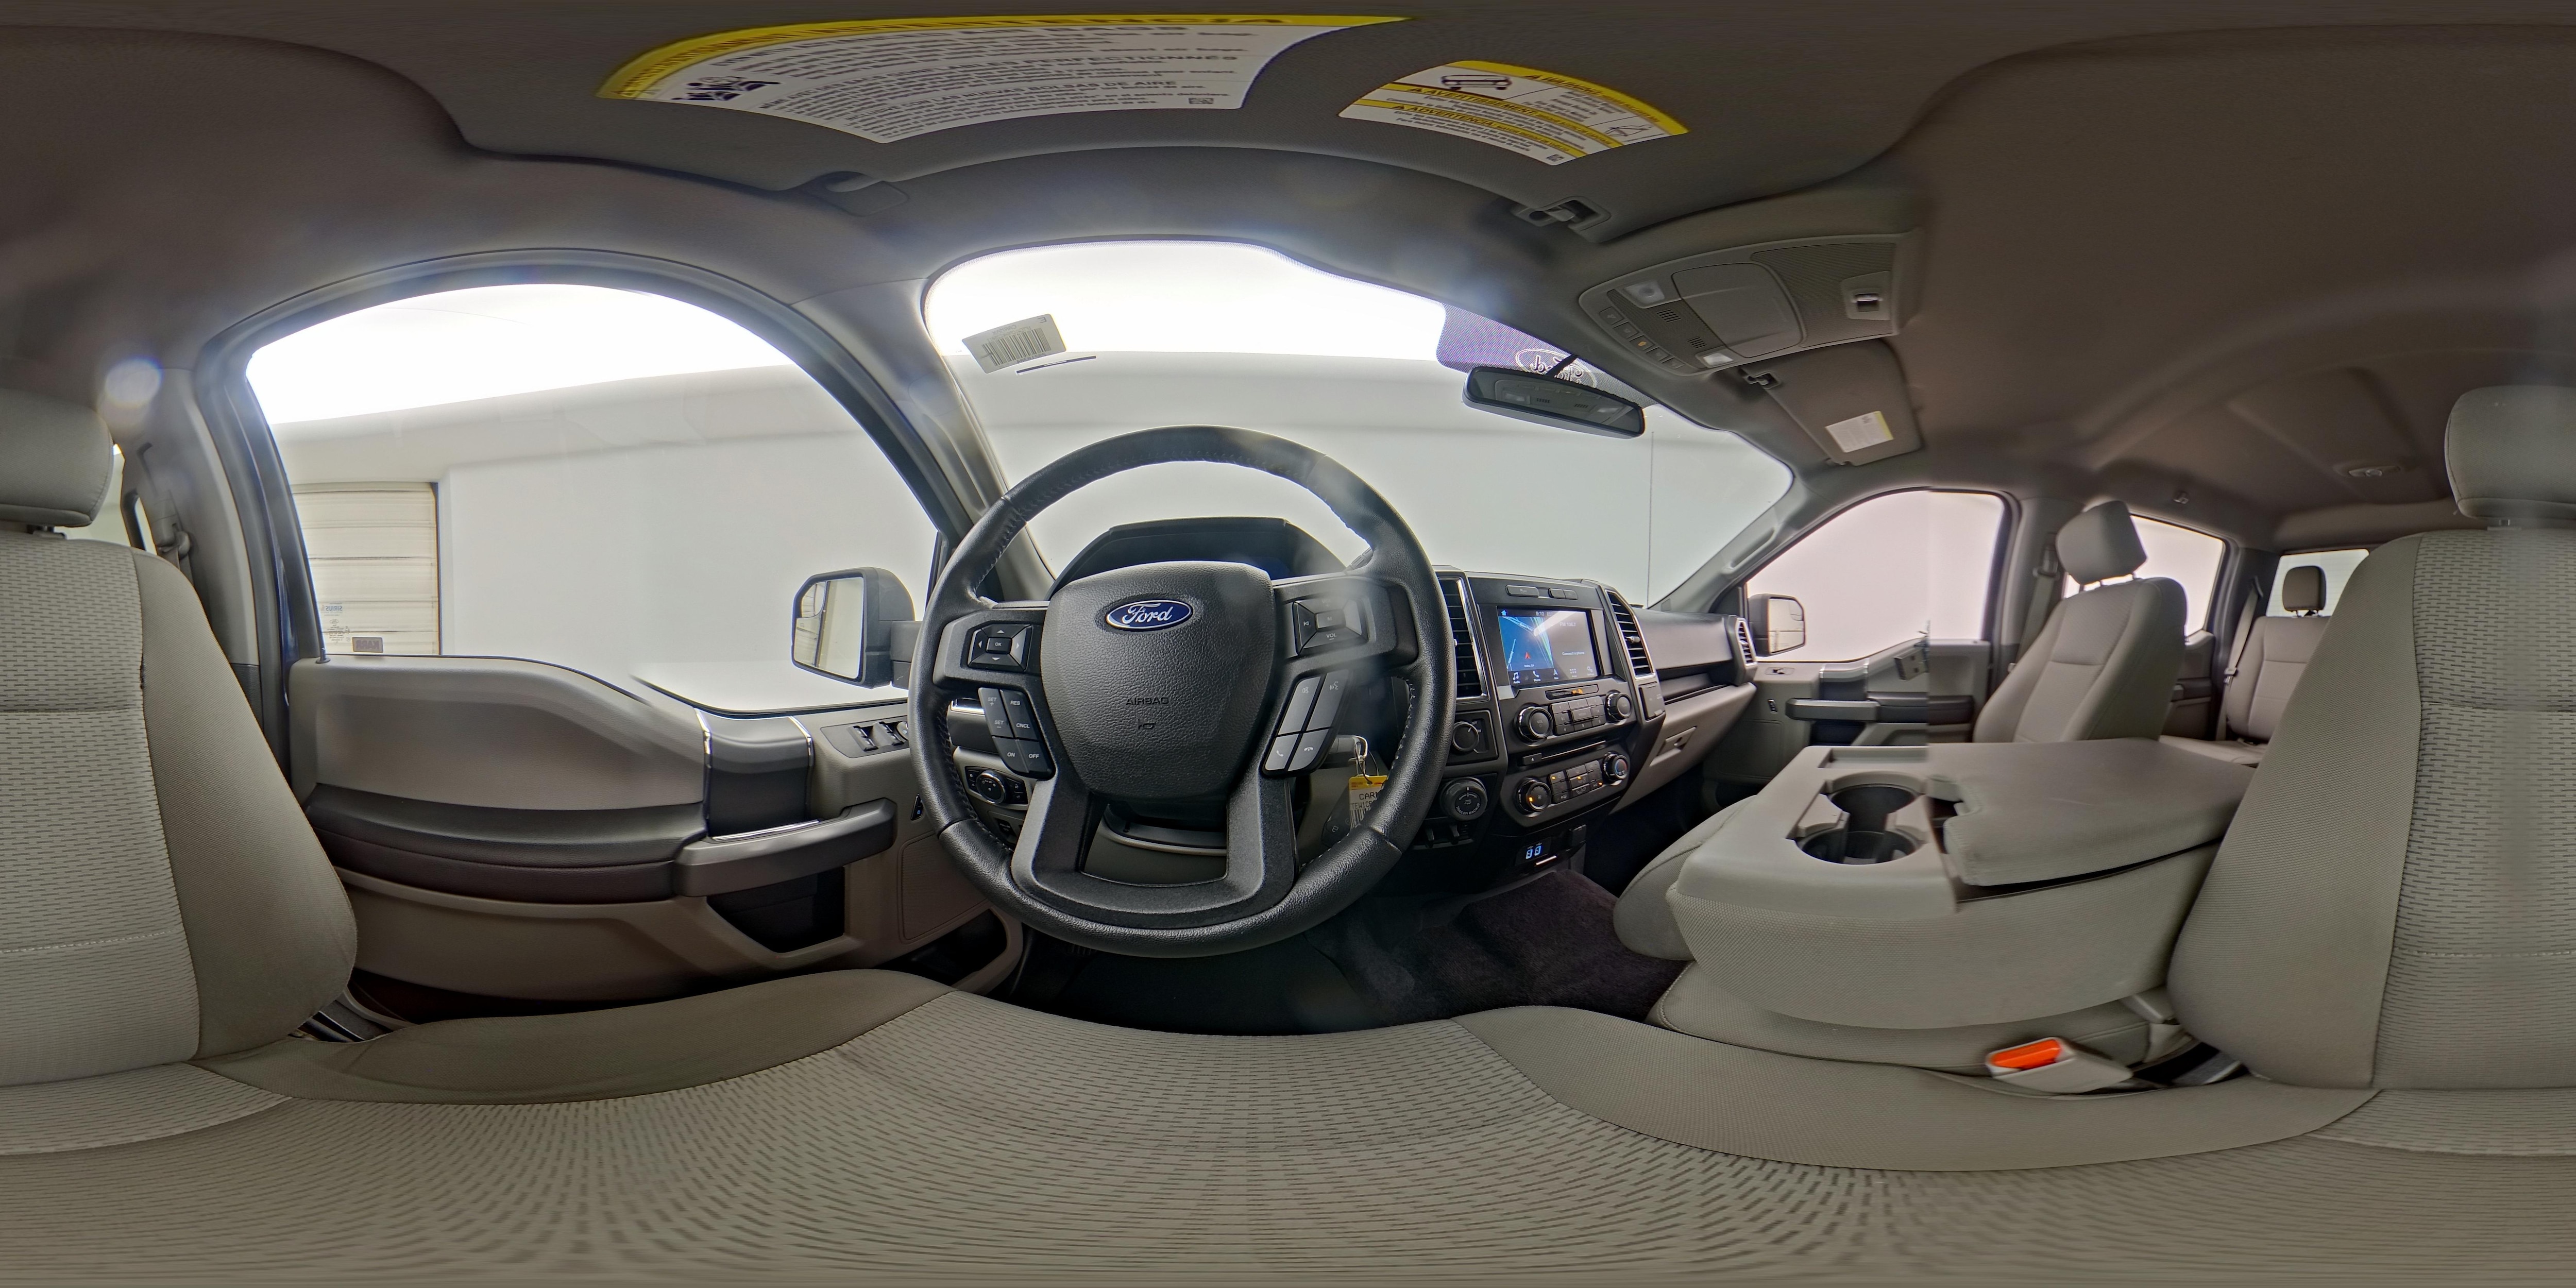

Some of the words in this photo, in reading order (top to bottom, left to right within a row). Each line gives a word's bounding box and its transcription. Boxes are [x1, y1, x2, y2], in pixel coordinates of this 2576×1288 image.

[1122, 603, 1174, 624] Ford
[1125, 697, 1170, 705] AIRBAG
[1455, 806, 1468, 816] TRAILER
[1468, 802, 1481, 816] BACKUP
